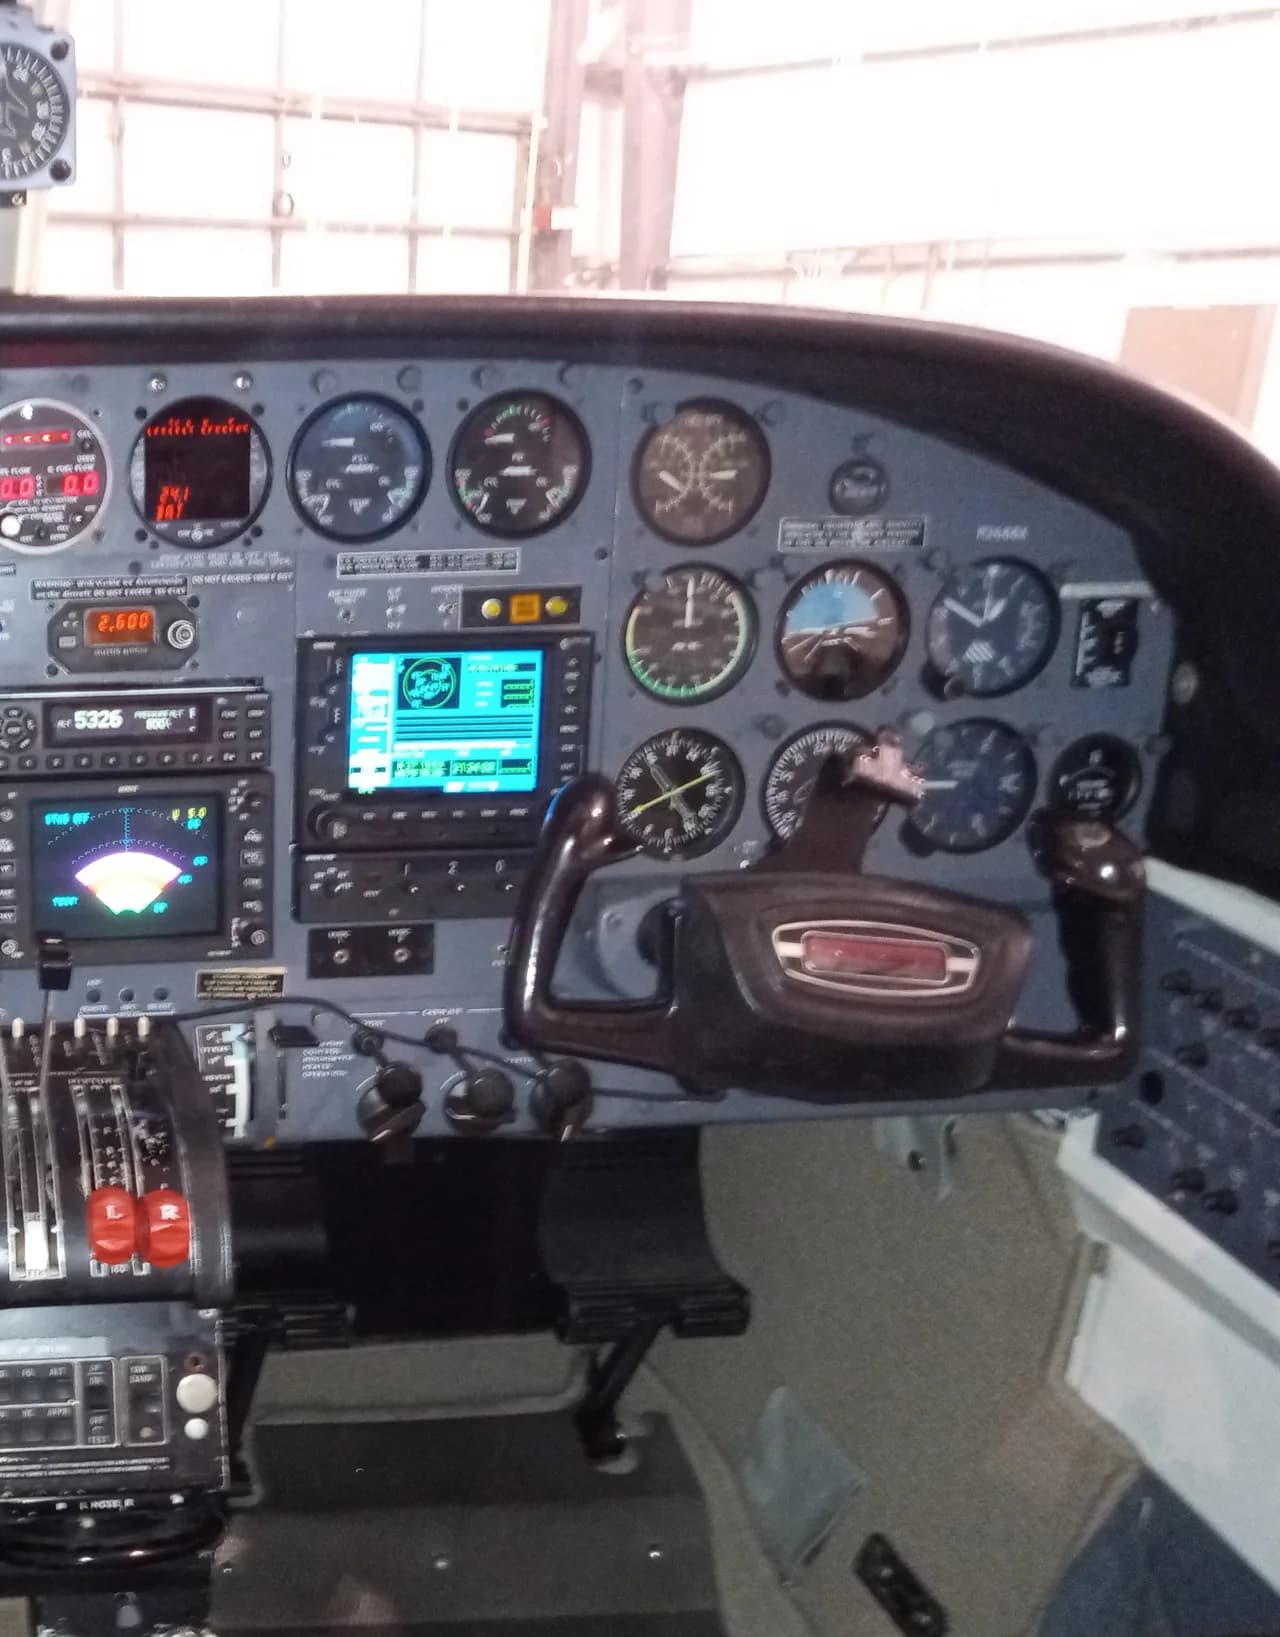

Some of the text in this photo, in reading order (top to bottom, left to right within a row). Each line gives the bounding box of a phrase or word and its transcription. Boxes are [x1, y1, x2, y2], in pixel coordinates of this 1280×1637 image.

[74, 708, 124, 730] 5326
[448, 860, 459, 875] 2
[105, 1204, 180, 1220] L R
